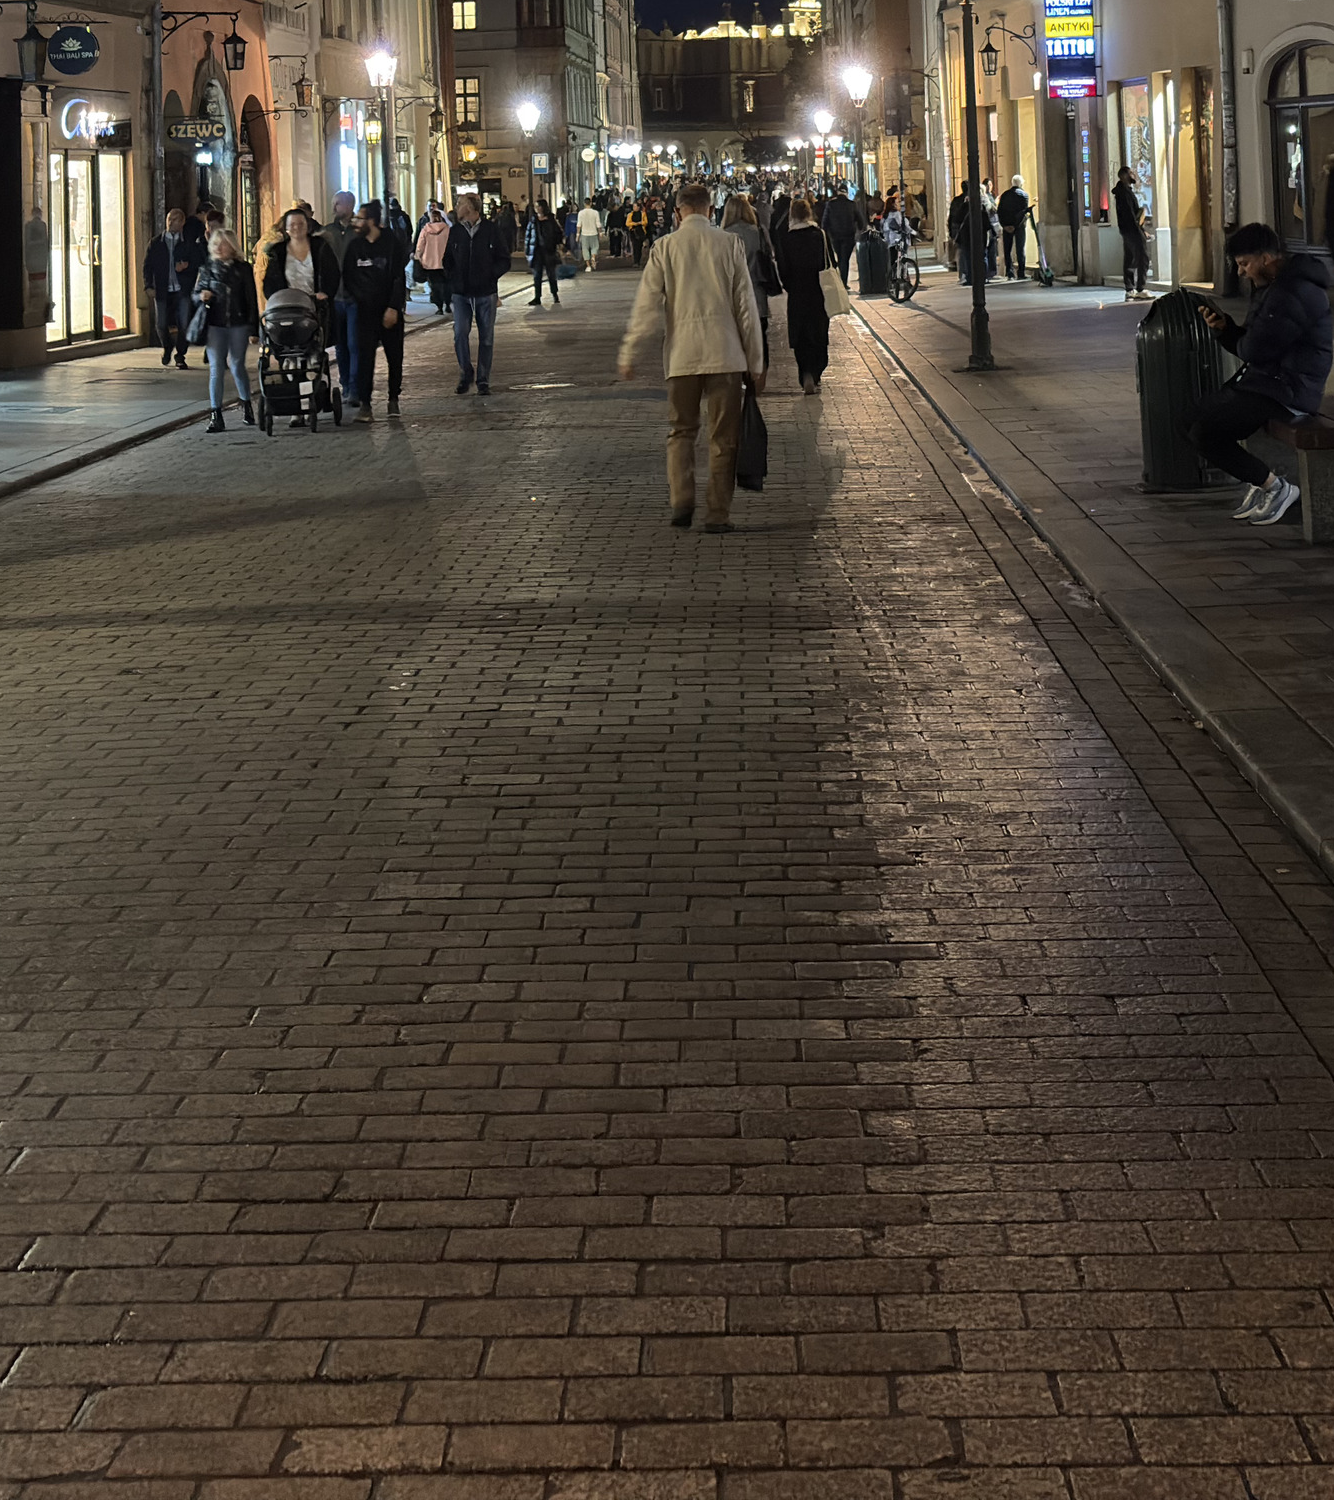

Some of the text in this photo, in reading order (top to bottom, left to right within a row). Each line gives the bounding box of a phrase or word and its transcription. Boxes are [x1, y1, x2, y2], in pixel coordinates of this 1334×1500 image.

[1050, 21, 1090, 32] ANTYKI
[1046, 38, 1094, 56] TATTOO
[81, 51, 94, 59] SPA
[169, 123, 224, 138] SZEWC
